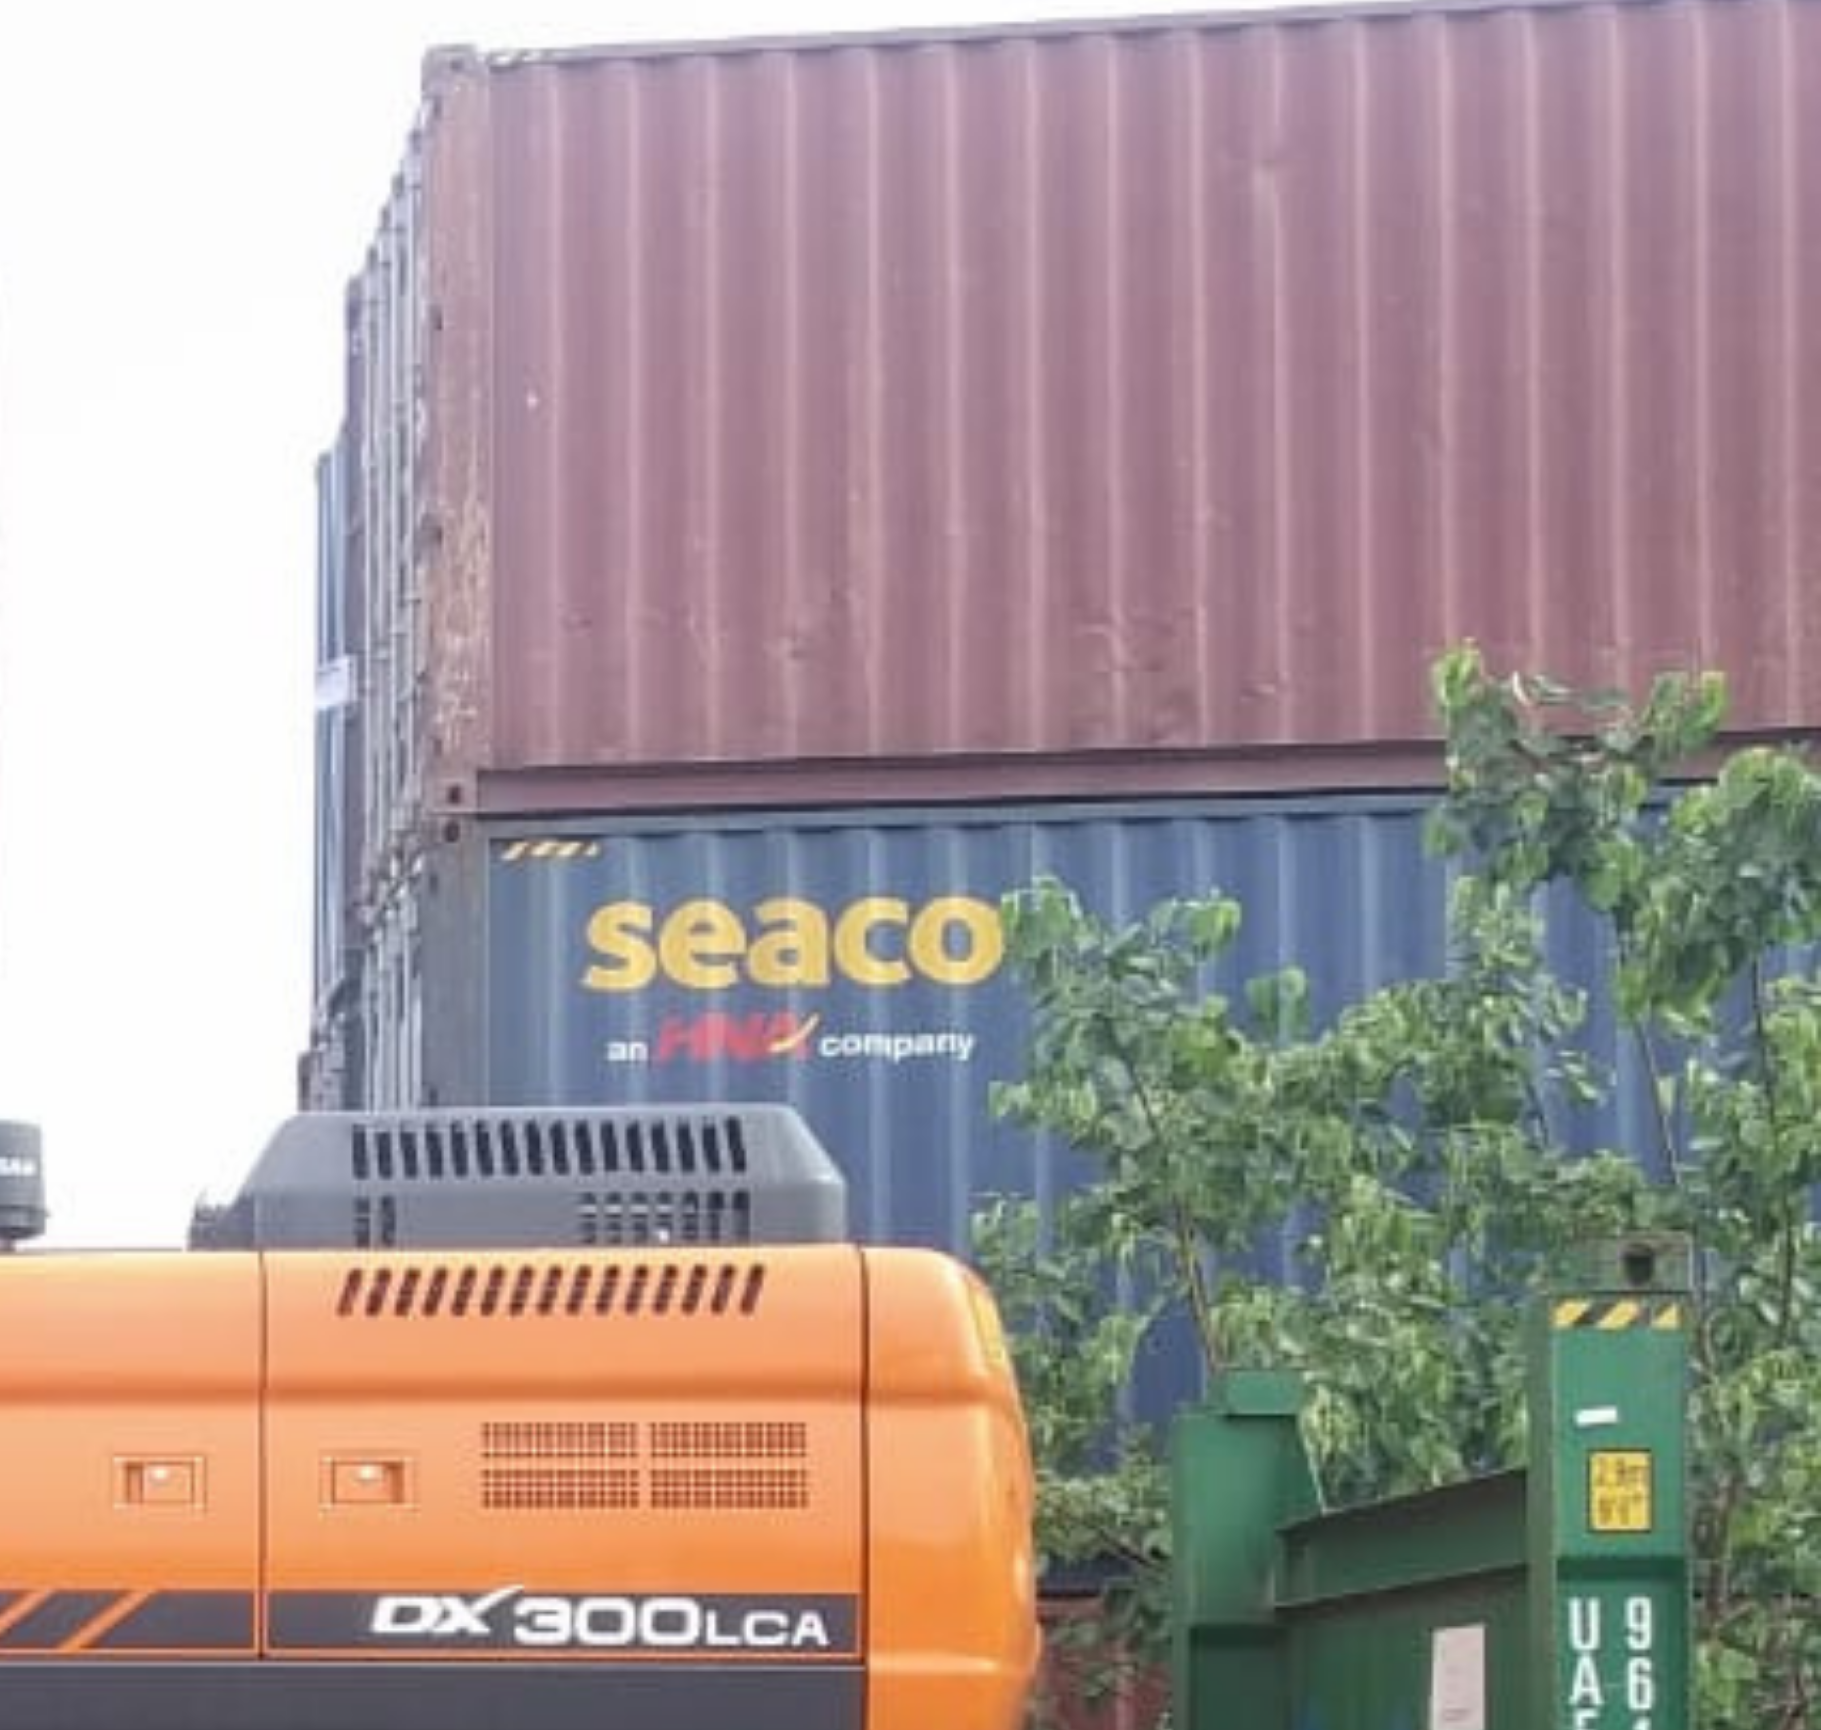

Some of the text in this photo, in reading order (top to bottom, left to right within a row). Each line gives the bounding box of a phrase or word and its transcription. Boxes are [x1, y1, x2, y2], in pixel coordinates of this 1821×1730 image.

[582, 896, 1004, 991] seaco
[607, 1041, 648, 1062] an
[819, 1033, 975, 1062] company
